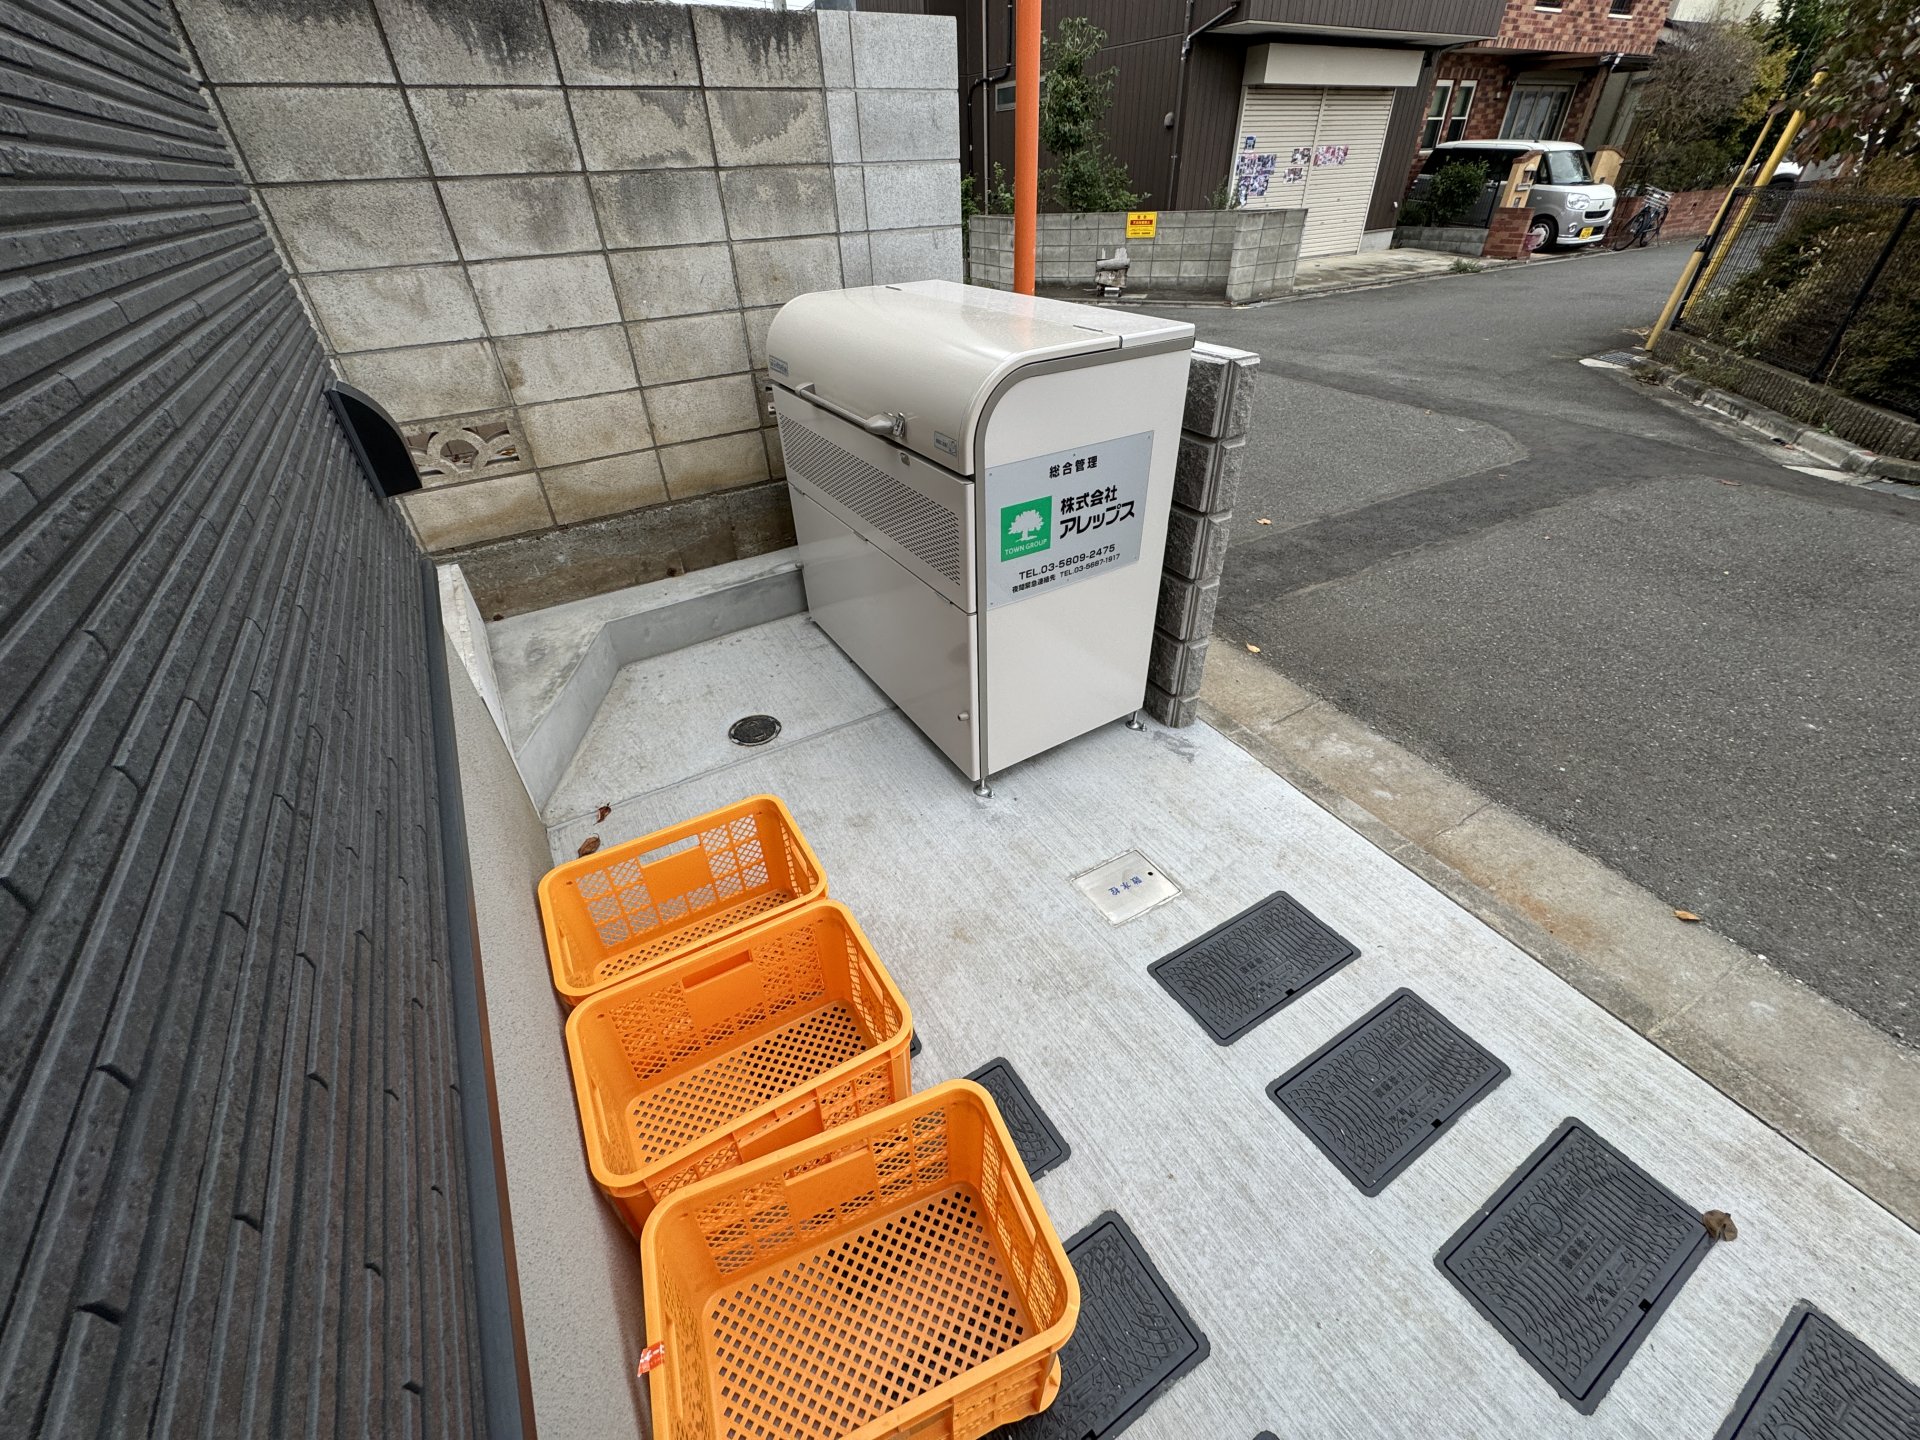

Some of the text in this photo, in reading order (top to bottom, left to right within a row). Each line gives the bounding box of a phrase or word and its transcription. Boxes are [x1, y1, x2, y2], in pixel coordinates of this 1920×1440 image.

[1049, 455, 1098, 479] 総合管理
[1060, 485, 1118, 515] 株式会社
[1060, 500, 1135, 539] アレップス
[1005, 538, 1047, 555] TOWN GROUP
[1019, 544, 1116, 580] TEL.03-5809-2475
